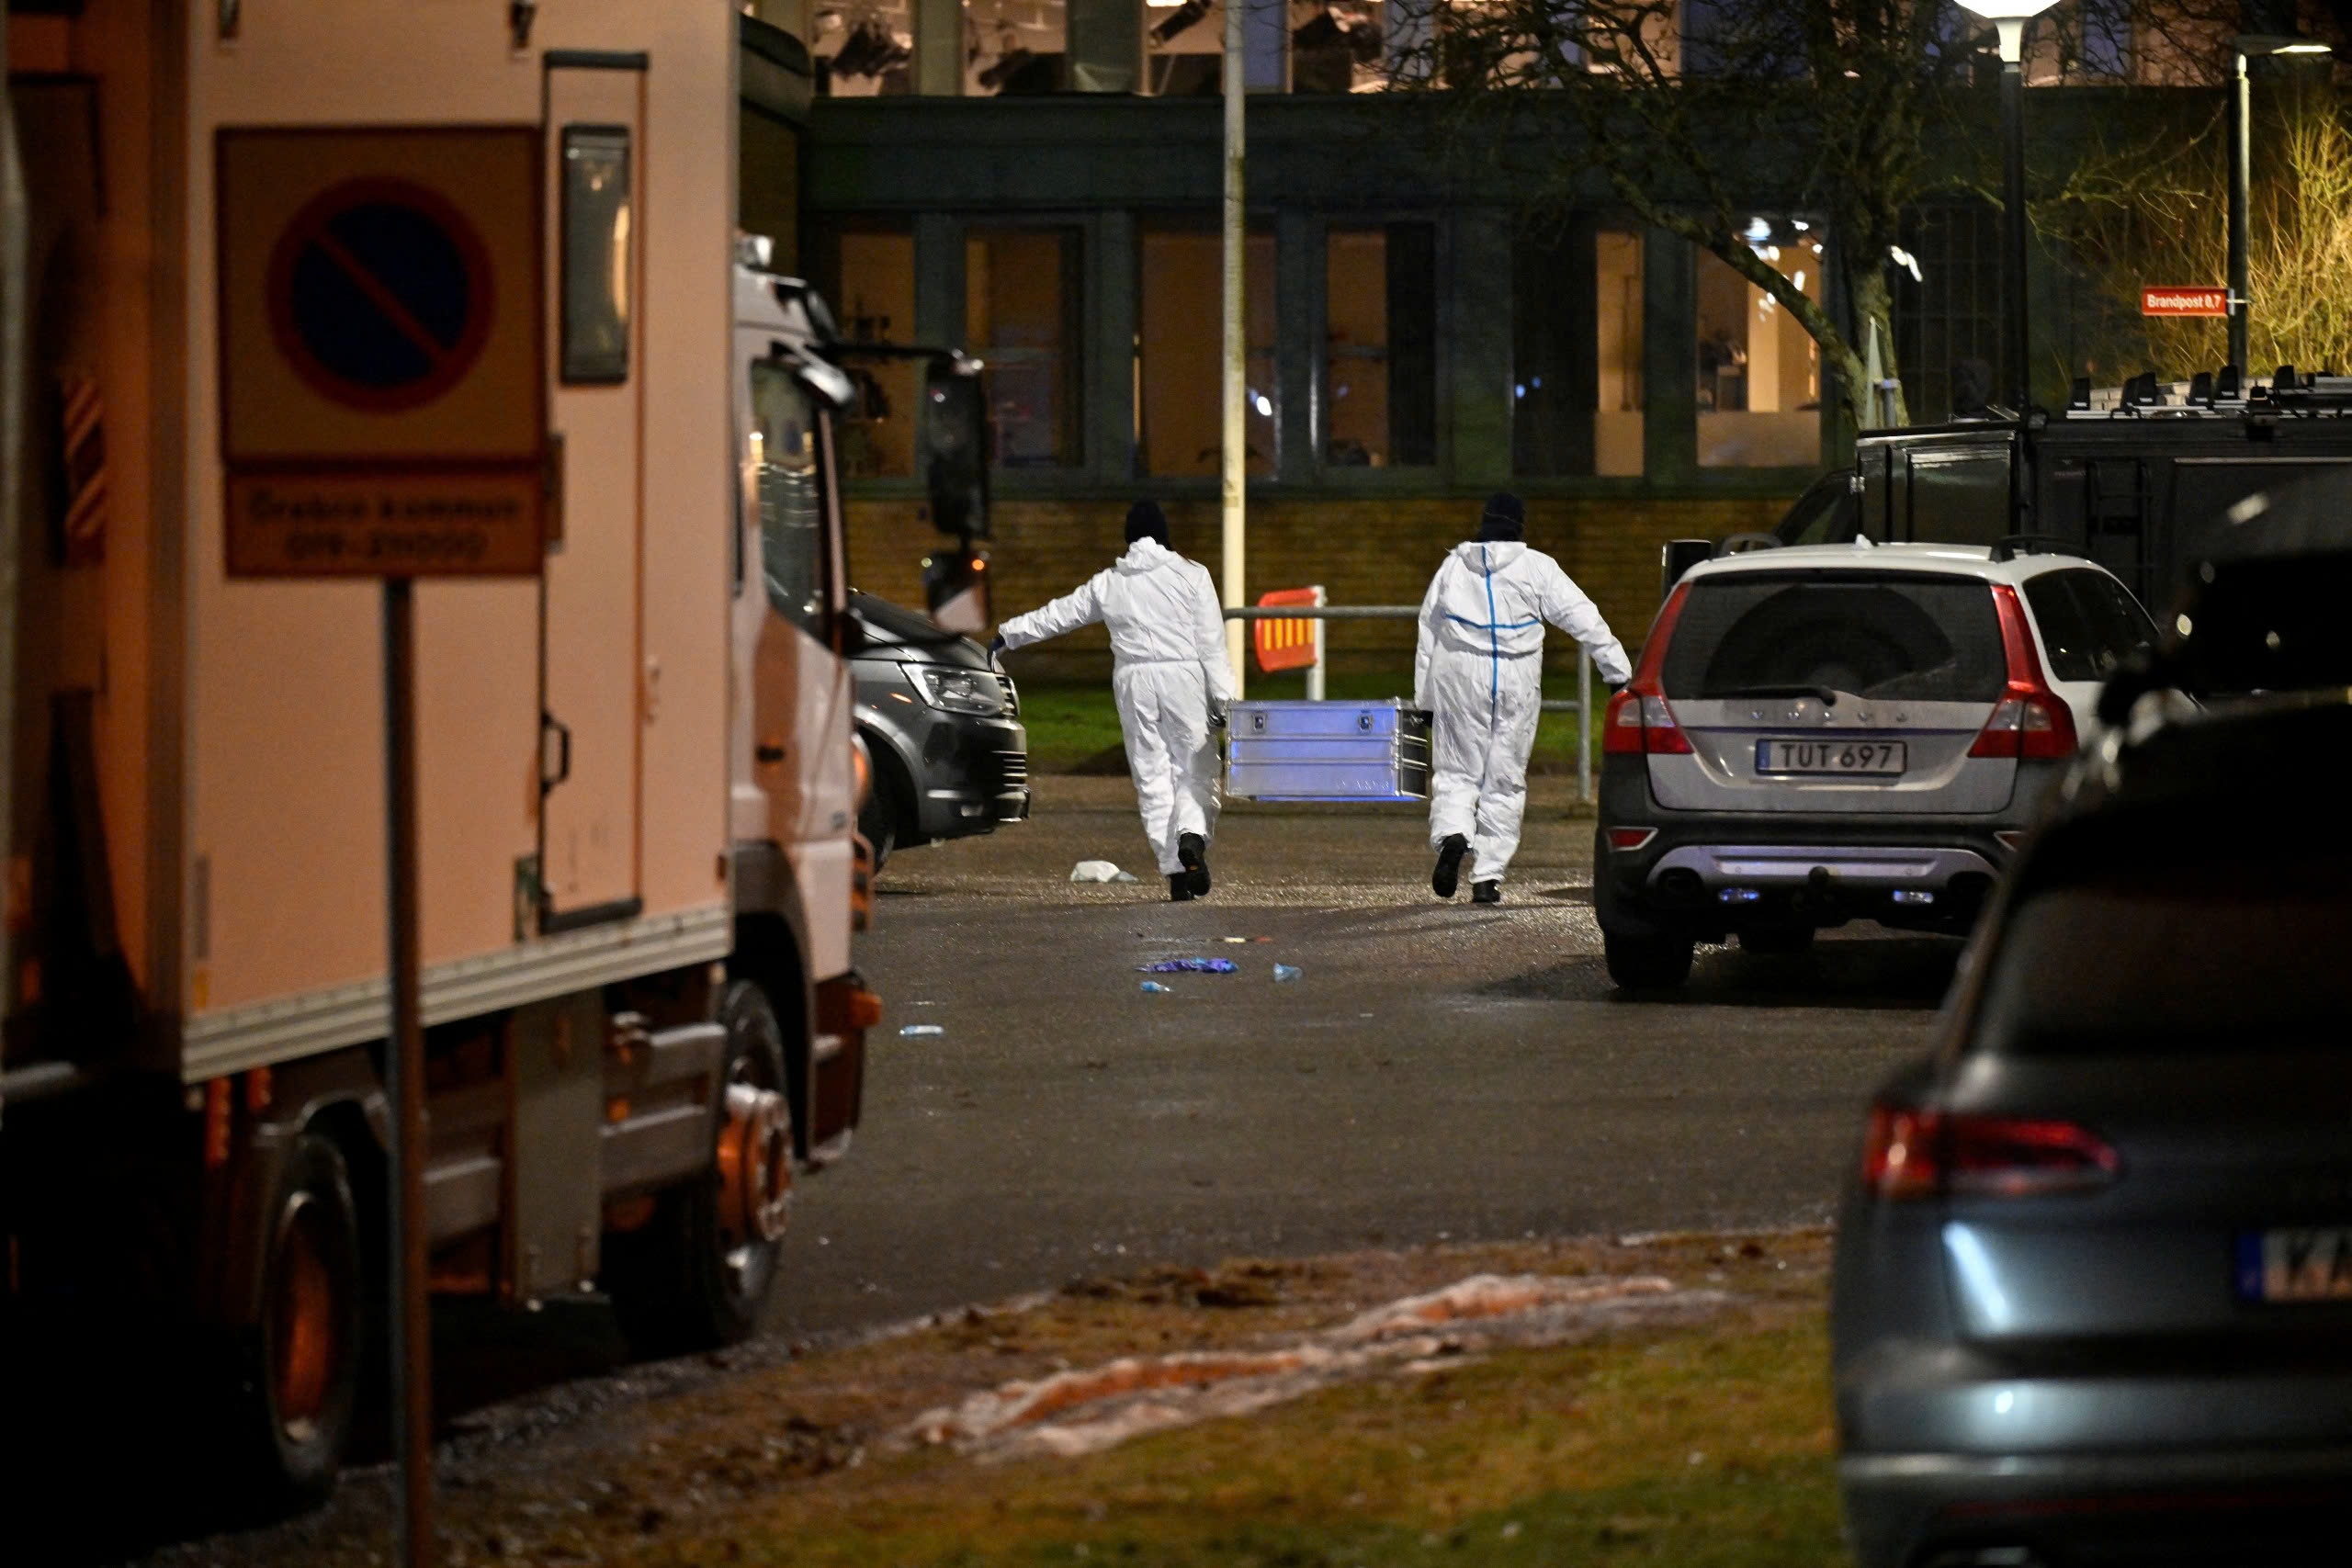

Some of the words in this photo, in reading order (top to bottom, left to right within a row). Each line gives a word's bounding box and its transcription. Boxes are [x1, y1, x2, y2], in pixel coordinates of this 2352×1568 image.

[2146, 293, 2204, 310] Brandpost
[378, 491, 520, 521] kommun
[1781, 744, 1831, 768] TUT
[1840, 745, 1893, 769] 697
